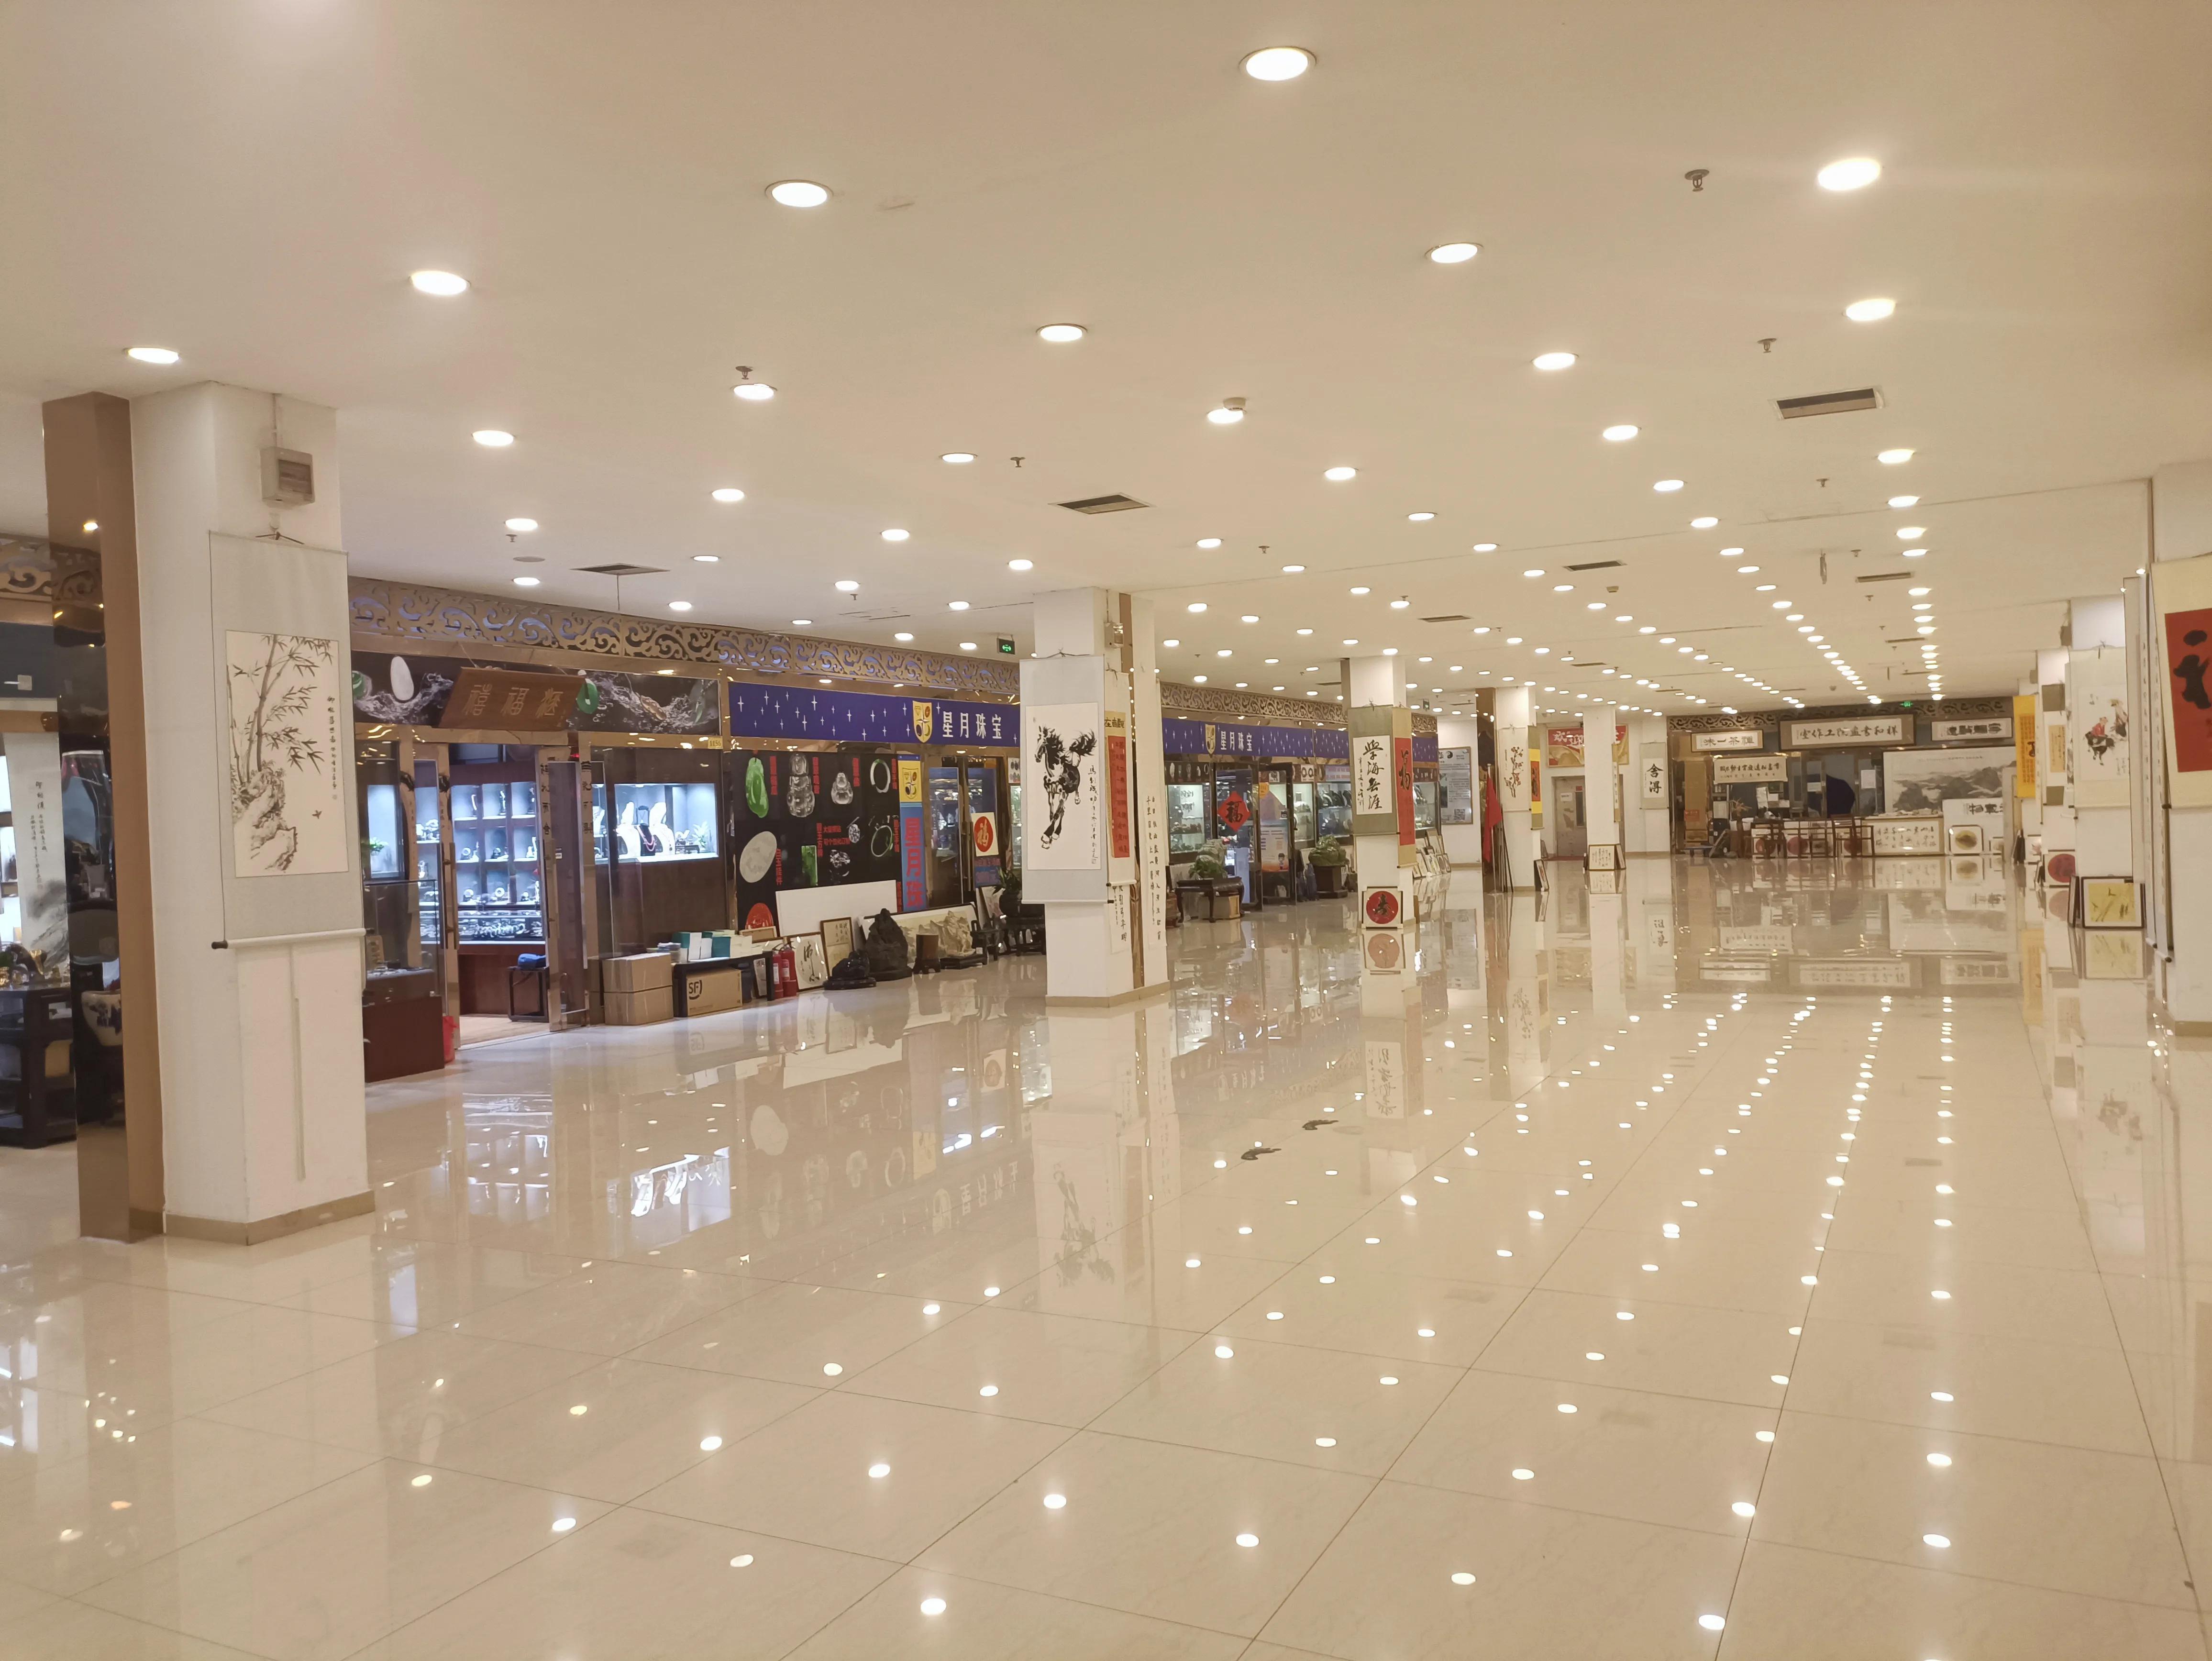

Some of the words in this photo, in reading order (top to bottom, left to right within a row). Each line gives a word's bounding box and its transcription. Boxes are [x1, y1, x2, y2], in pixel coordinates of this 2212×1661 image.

[943, 711, 1002, 739] 星月珠宝
[1221, 731, 1252, 751] 星月珠宝
[689, 981, 699, 994] SF
